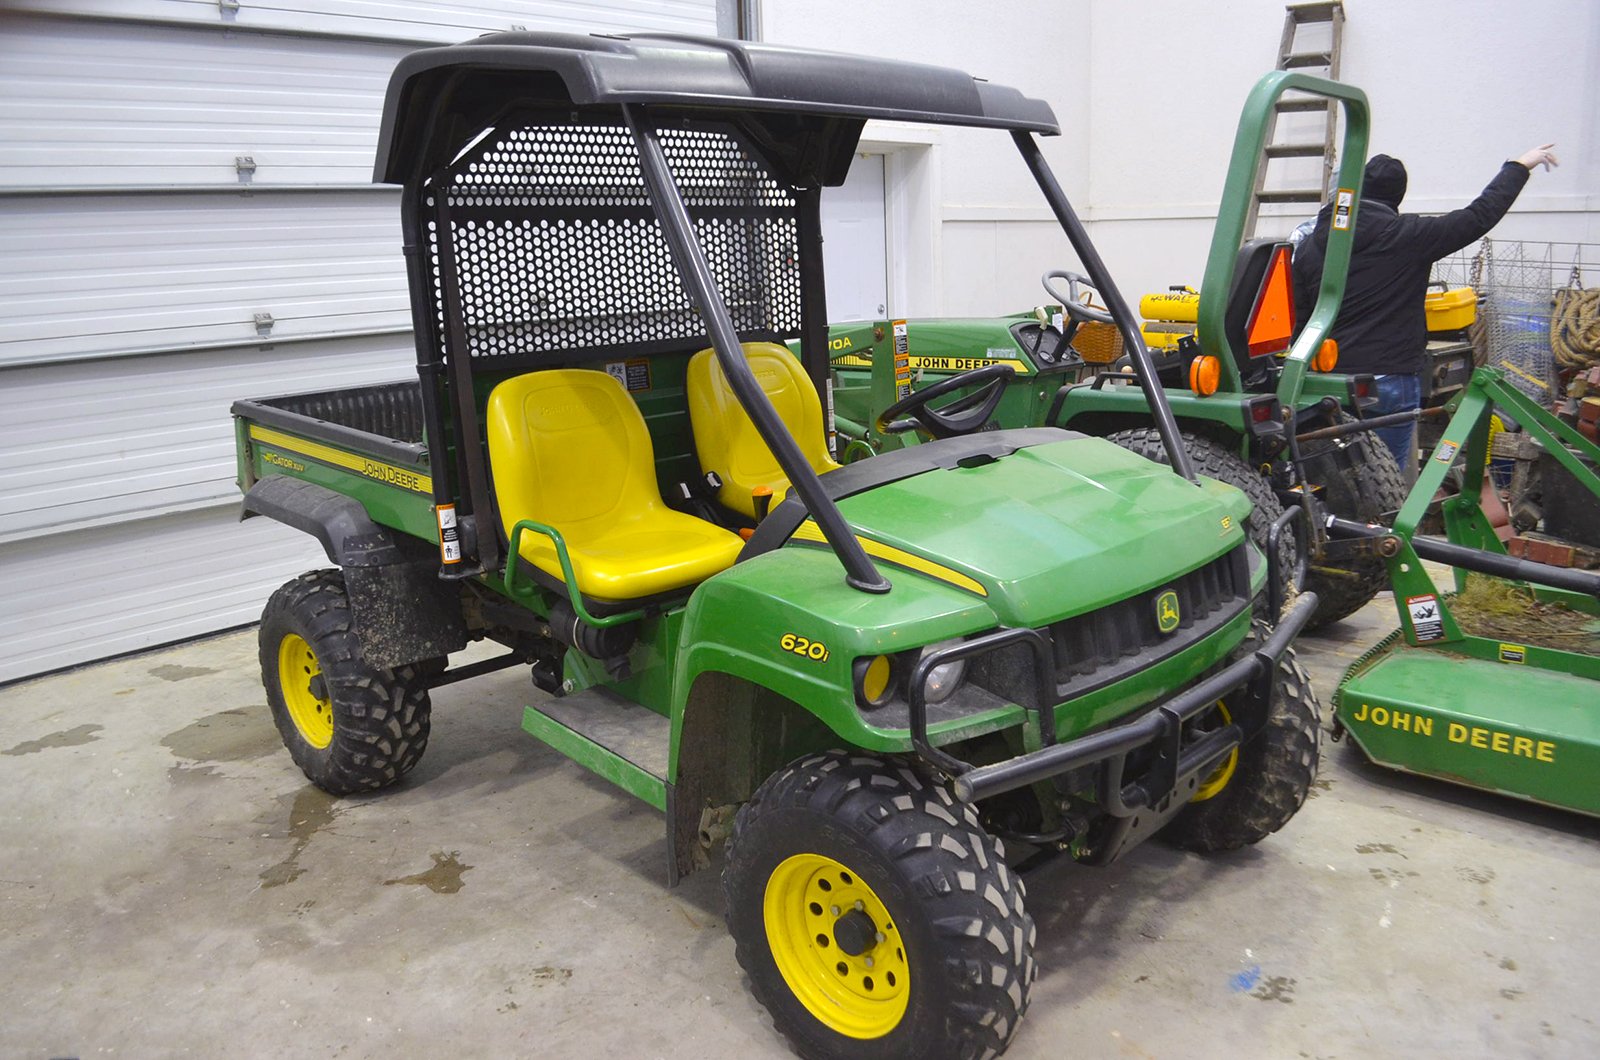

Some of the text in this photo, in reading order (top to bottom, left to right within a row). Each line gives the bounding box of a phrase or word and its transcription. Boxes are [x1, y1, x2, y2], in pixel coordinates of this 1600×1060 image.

[916, 357, 949, 369] JOHN
[362, 459, 420, 490] JOHN DEERE
[780, 633, 830, 663] 620i
[1354, 704, 1557, 763] JOHN DEERE
